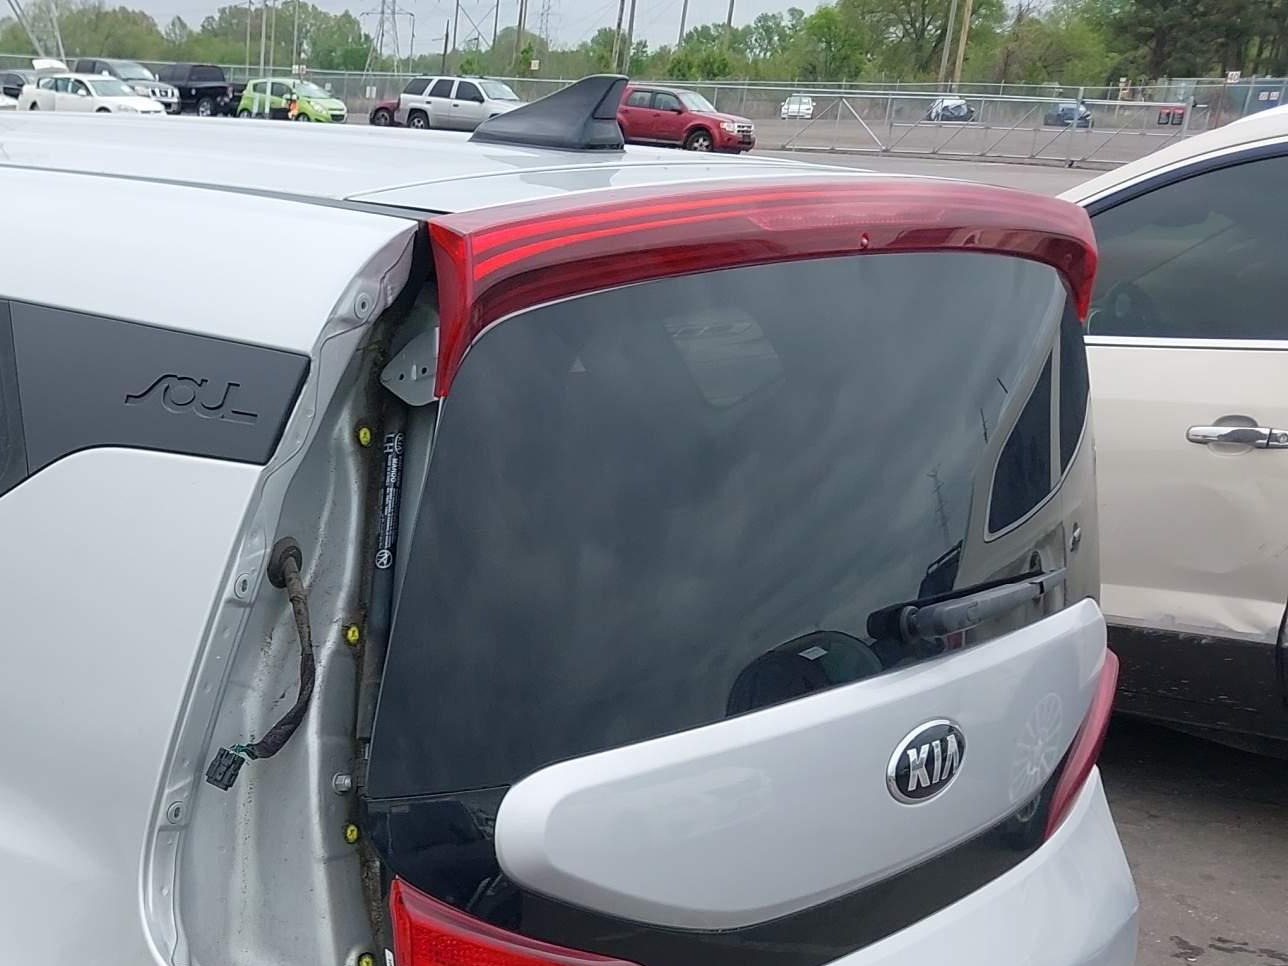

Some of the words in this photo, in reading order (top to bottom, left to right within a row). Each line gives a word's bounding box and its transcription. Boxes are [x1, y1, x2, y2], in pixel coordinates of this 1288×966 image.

[125, 373, 258, 425] SOUL
[383, 434, 394, 453] LH
[906, 733, 960, 792] KIA
